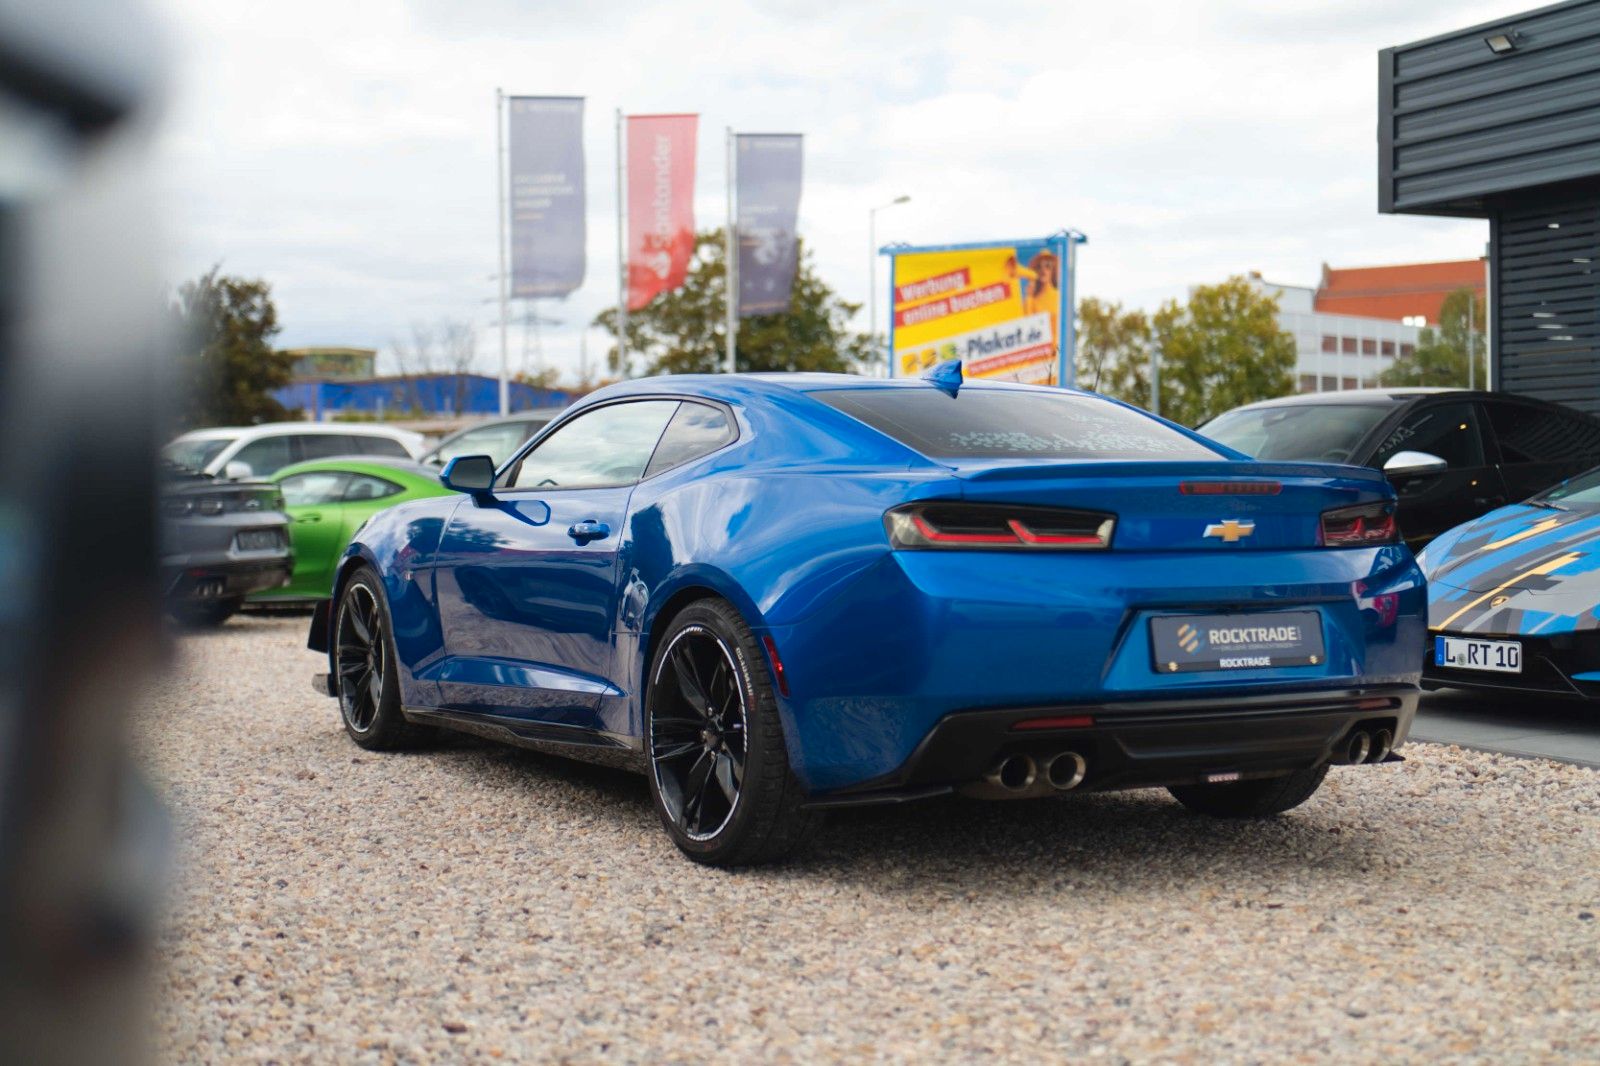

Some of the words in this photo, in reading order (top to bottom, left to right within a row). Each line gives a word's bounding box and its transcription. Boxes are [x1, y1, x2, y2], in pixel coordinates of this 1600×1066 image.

[652, 133, 671, 246] Santander
[1208, 627, 1297, 645] ROCKTRADE
[1219, 656, 1271, 668] ROCKTRADE
[1445, 642, 1455, 663] L
[1468, 643, 1491, 666] RT
[1495, 645, 1519, 668] 10
